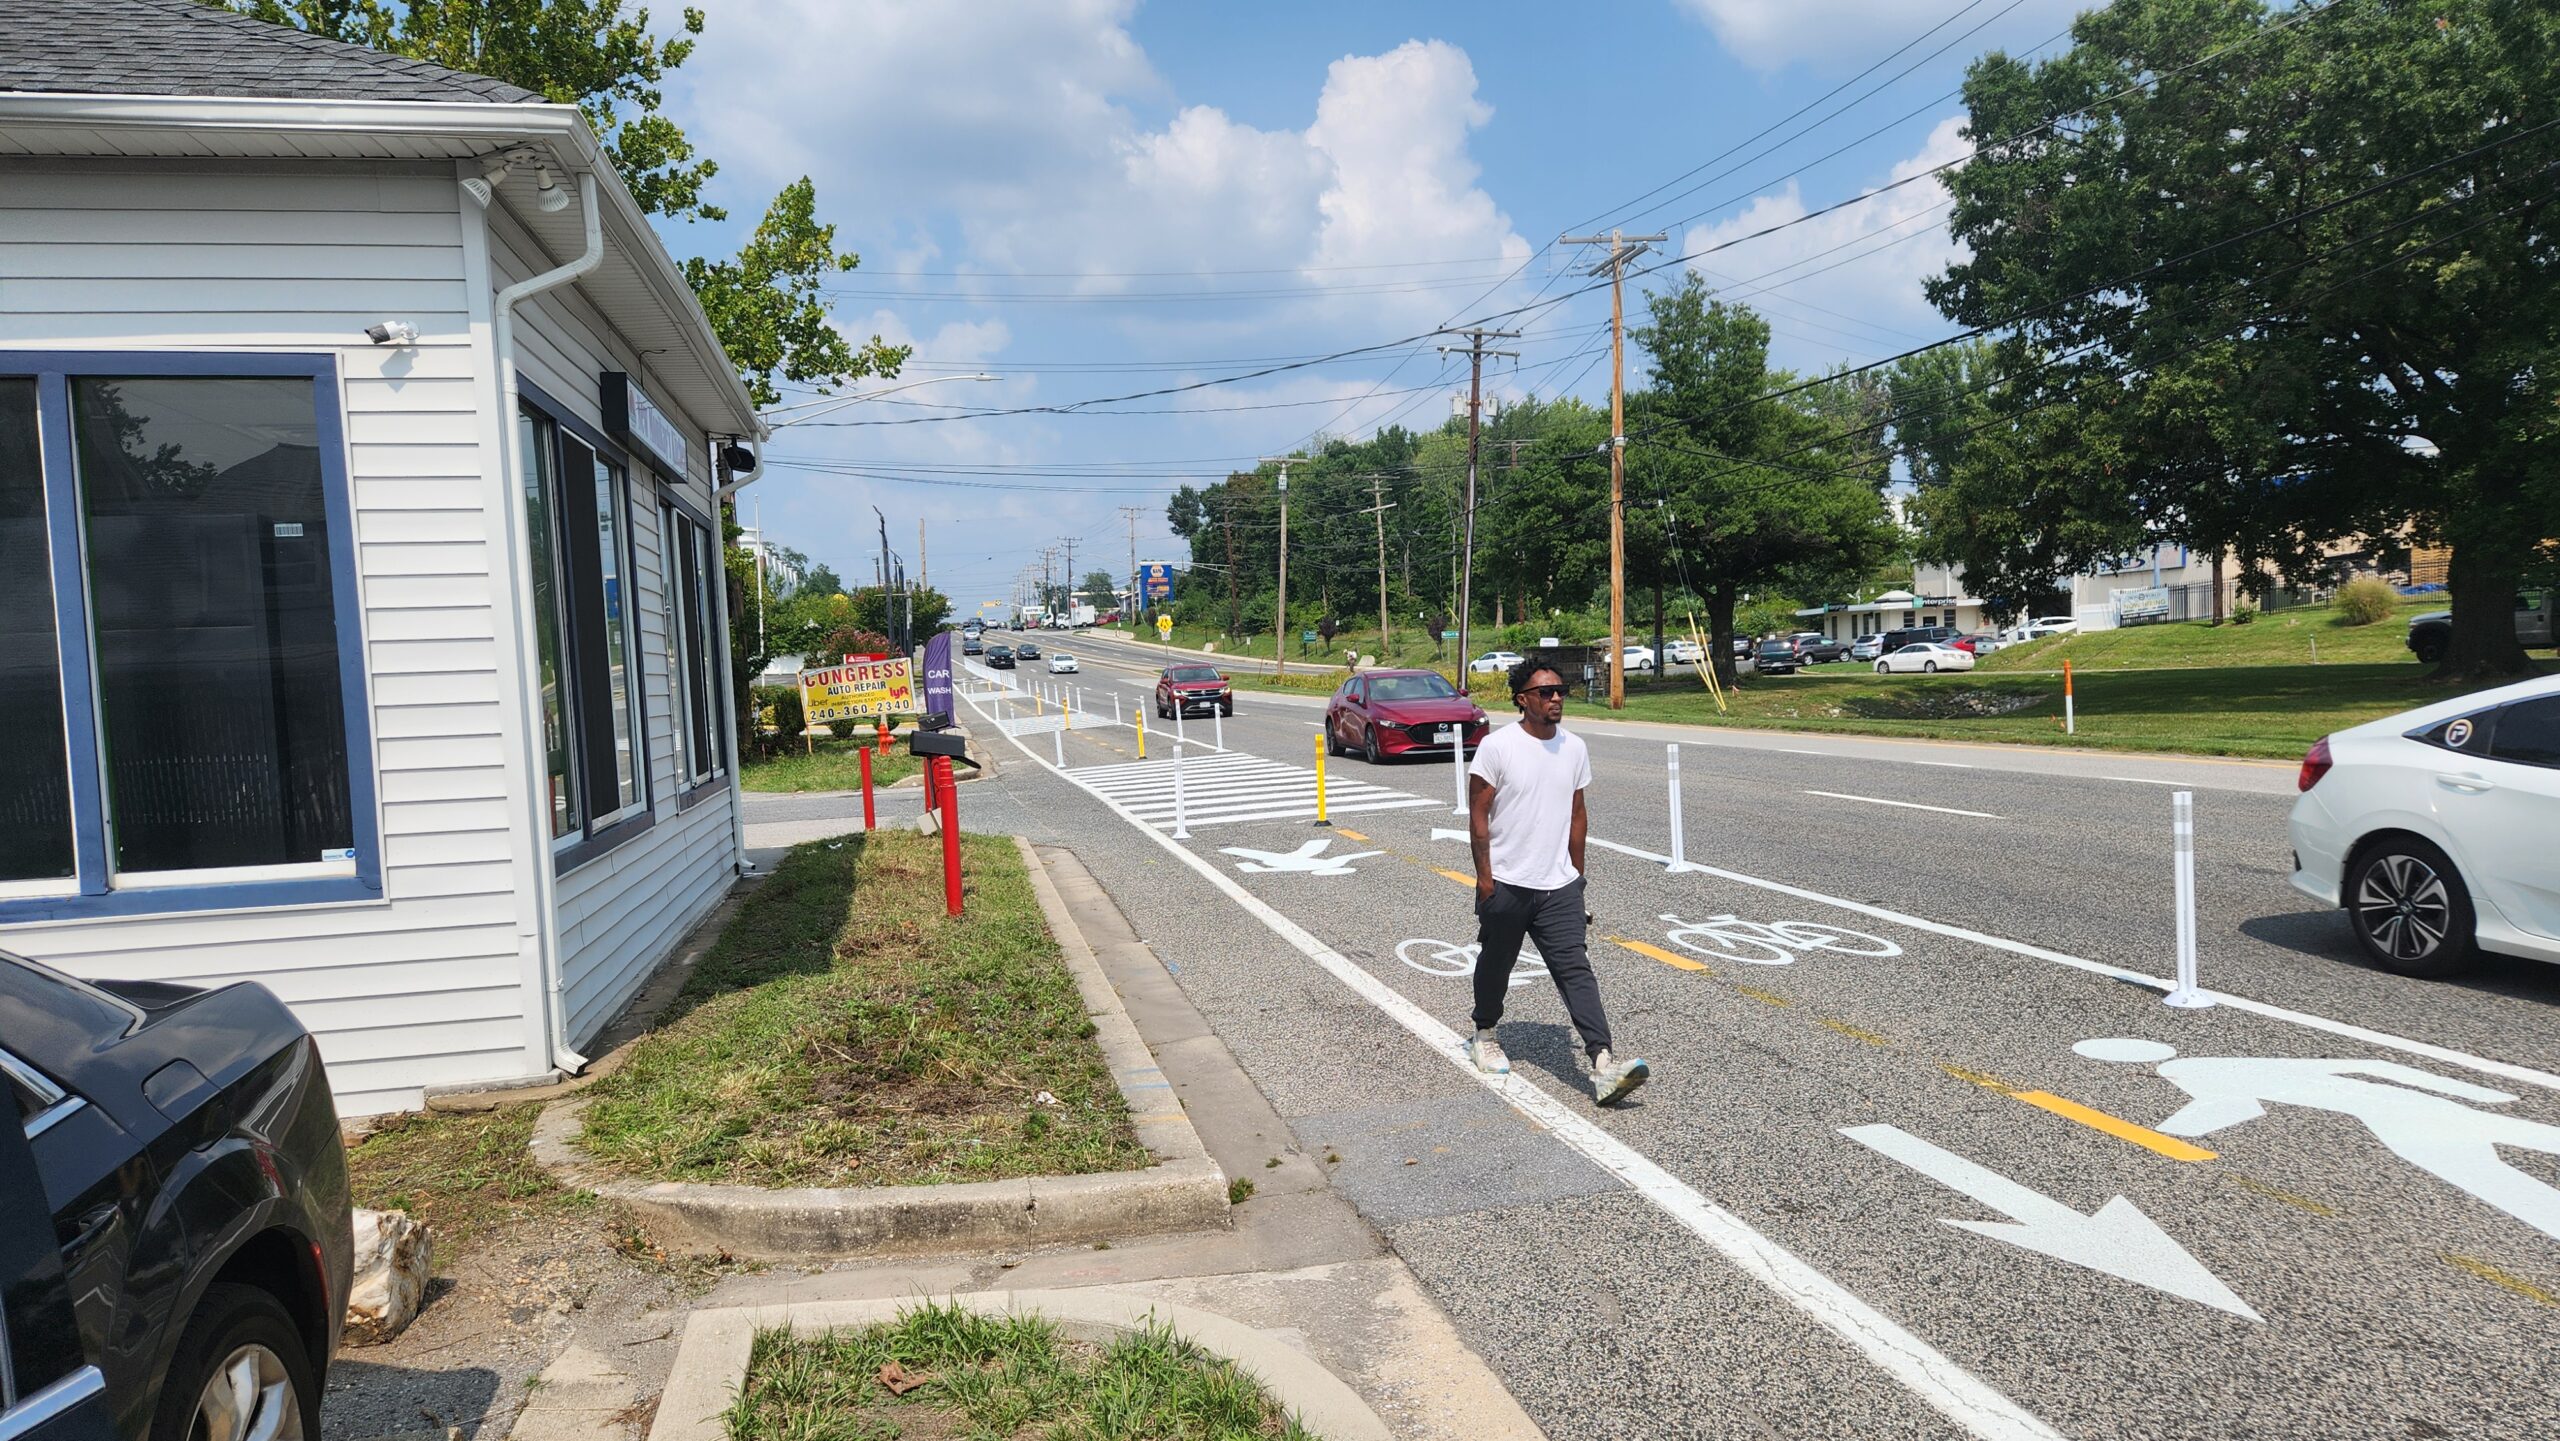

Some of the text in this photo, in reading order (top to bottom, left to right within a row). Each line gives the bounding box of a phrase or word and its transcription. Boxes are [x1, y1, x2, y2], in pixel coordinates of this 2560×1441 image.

[805, 662, 905, 687] CONGRESS
[928, 669, 950, 679] CAR
[827, 681, 886, 696] AUTO REPAIR
[928, 687, 951, 695] WASH
[841, 692, 875, 700] AUTHORIZED
[831, 699, 863, 707] INSPECTION
[810, 700, 909, 720] 240-360-2340
